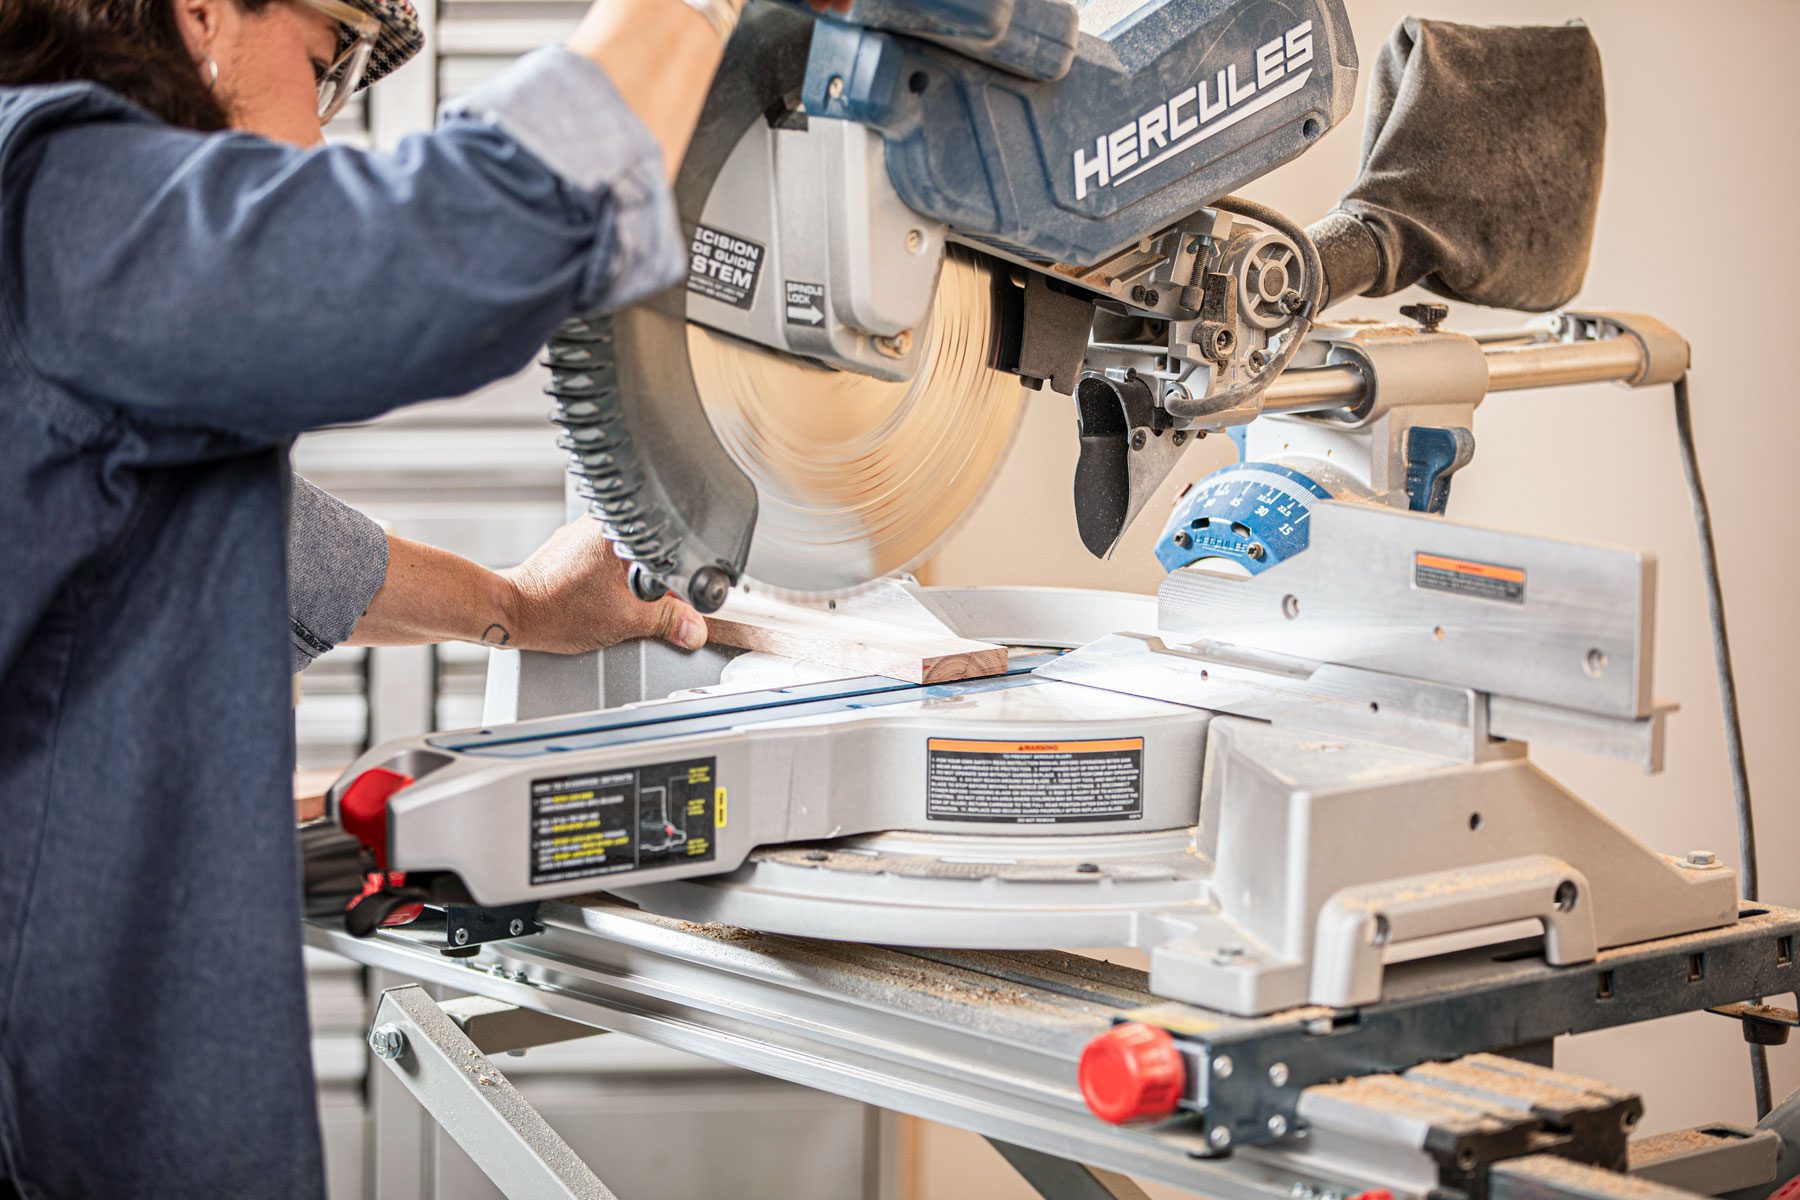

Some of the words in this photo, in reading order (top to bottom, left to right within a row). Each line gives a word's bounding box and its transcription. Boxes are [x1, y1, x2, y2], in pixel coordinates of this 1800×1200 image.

[1073, 19, 1314, 201] HERCULES
[714, 249, 756, 273] GUIDE
[787, 282, 824, 296] SPINDLE
[787, 293, 811, 304] LOCK
[1254, 505, 1269, 517] 30
[1278, 523, 1294, 536] 15
